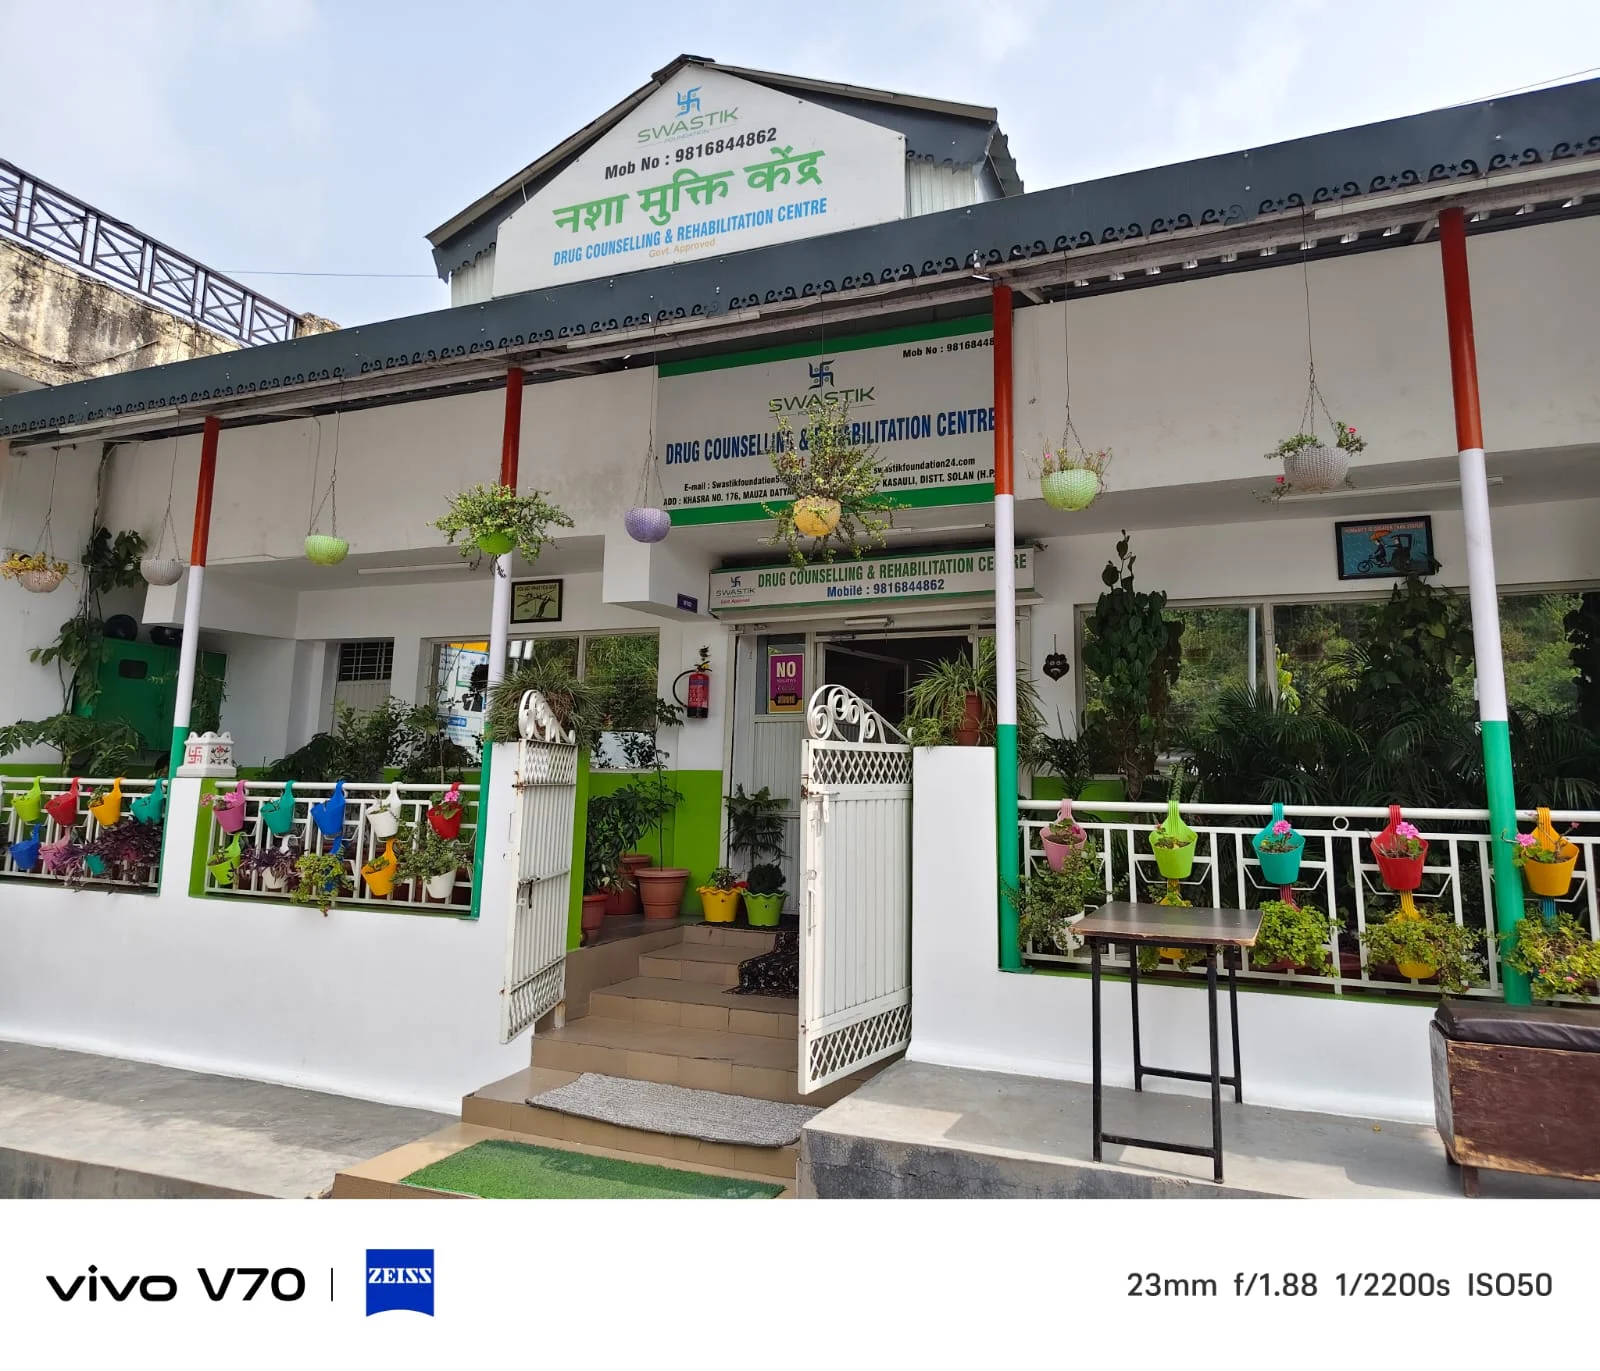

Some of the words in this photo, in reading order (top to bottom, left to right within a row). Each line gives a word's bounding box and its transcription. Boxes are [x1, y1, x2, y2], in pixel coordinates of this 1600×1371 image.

[637, 107, 739, 143] SWASTIK
[604, 160, 636, 180] Mob
[641, 154, 660, 171] No
[675, 127, 777, 163] 9816844862
[552, 193, 630, 233] नशा
[636, 168, 735, 227] मुक्ति
[743, 145, 826, 193] केंद्र
[553, 246, 583, 267] DRUG
[585, 230, 661, 260] COUNSELLING
[665, 228, 673, 245] &
[677, 209, 774, 242] REHABILITATION
[777, 197, 828, 223] CENTRE
[902, 348, 923, 358] Mob
[925, 346, 938, 355] No
[946, 338, 995, 352] 98168448
[769, 386, 876, 413] SWASTIK
[666, 440, 700, 465] DRUG
[799, 428, 809, 451] &
[936, 407, 995, 437] CENTRE
[663, 498, 677, 506] ADD
[683, 494, 710, 505] KHASRA
[711, 493, 724, 502] NO.
[726, 491, 741, 502] 176,
[742, 489, 767, 499] MAUZA
[882, 476, 918, 487] KASAULI,
[920, 473, 945, 484] DISTT.
[947, 471, 974, 482] SOLAN
[977, 468, 995, 480] (H.P.
[684, 482, 706, 492] E-mail
[758, 571, 786, 588] DRUG
[789, 565, 863, 586] COUNSELLING
[867, 564, 875, 580] &
[879, 556, 974, 579] REHABILITATION
[978, 553, 1027, 572] CERE
[873, 578, 945, 595] 9816844862
[715, 588, 756, 597] SWASTIK
[776, 661, 796, 678] NO
